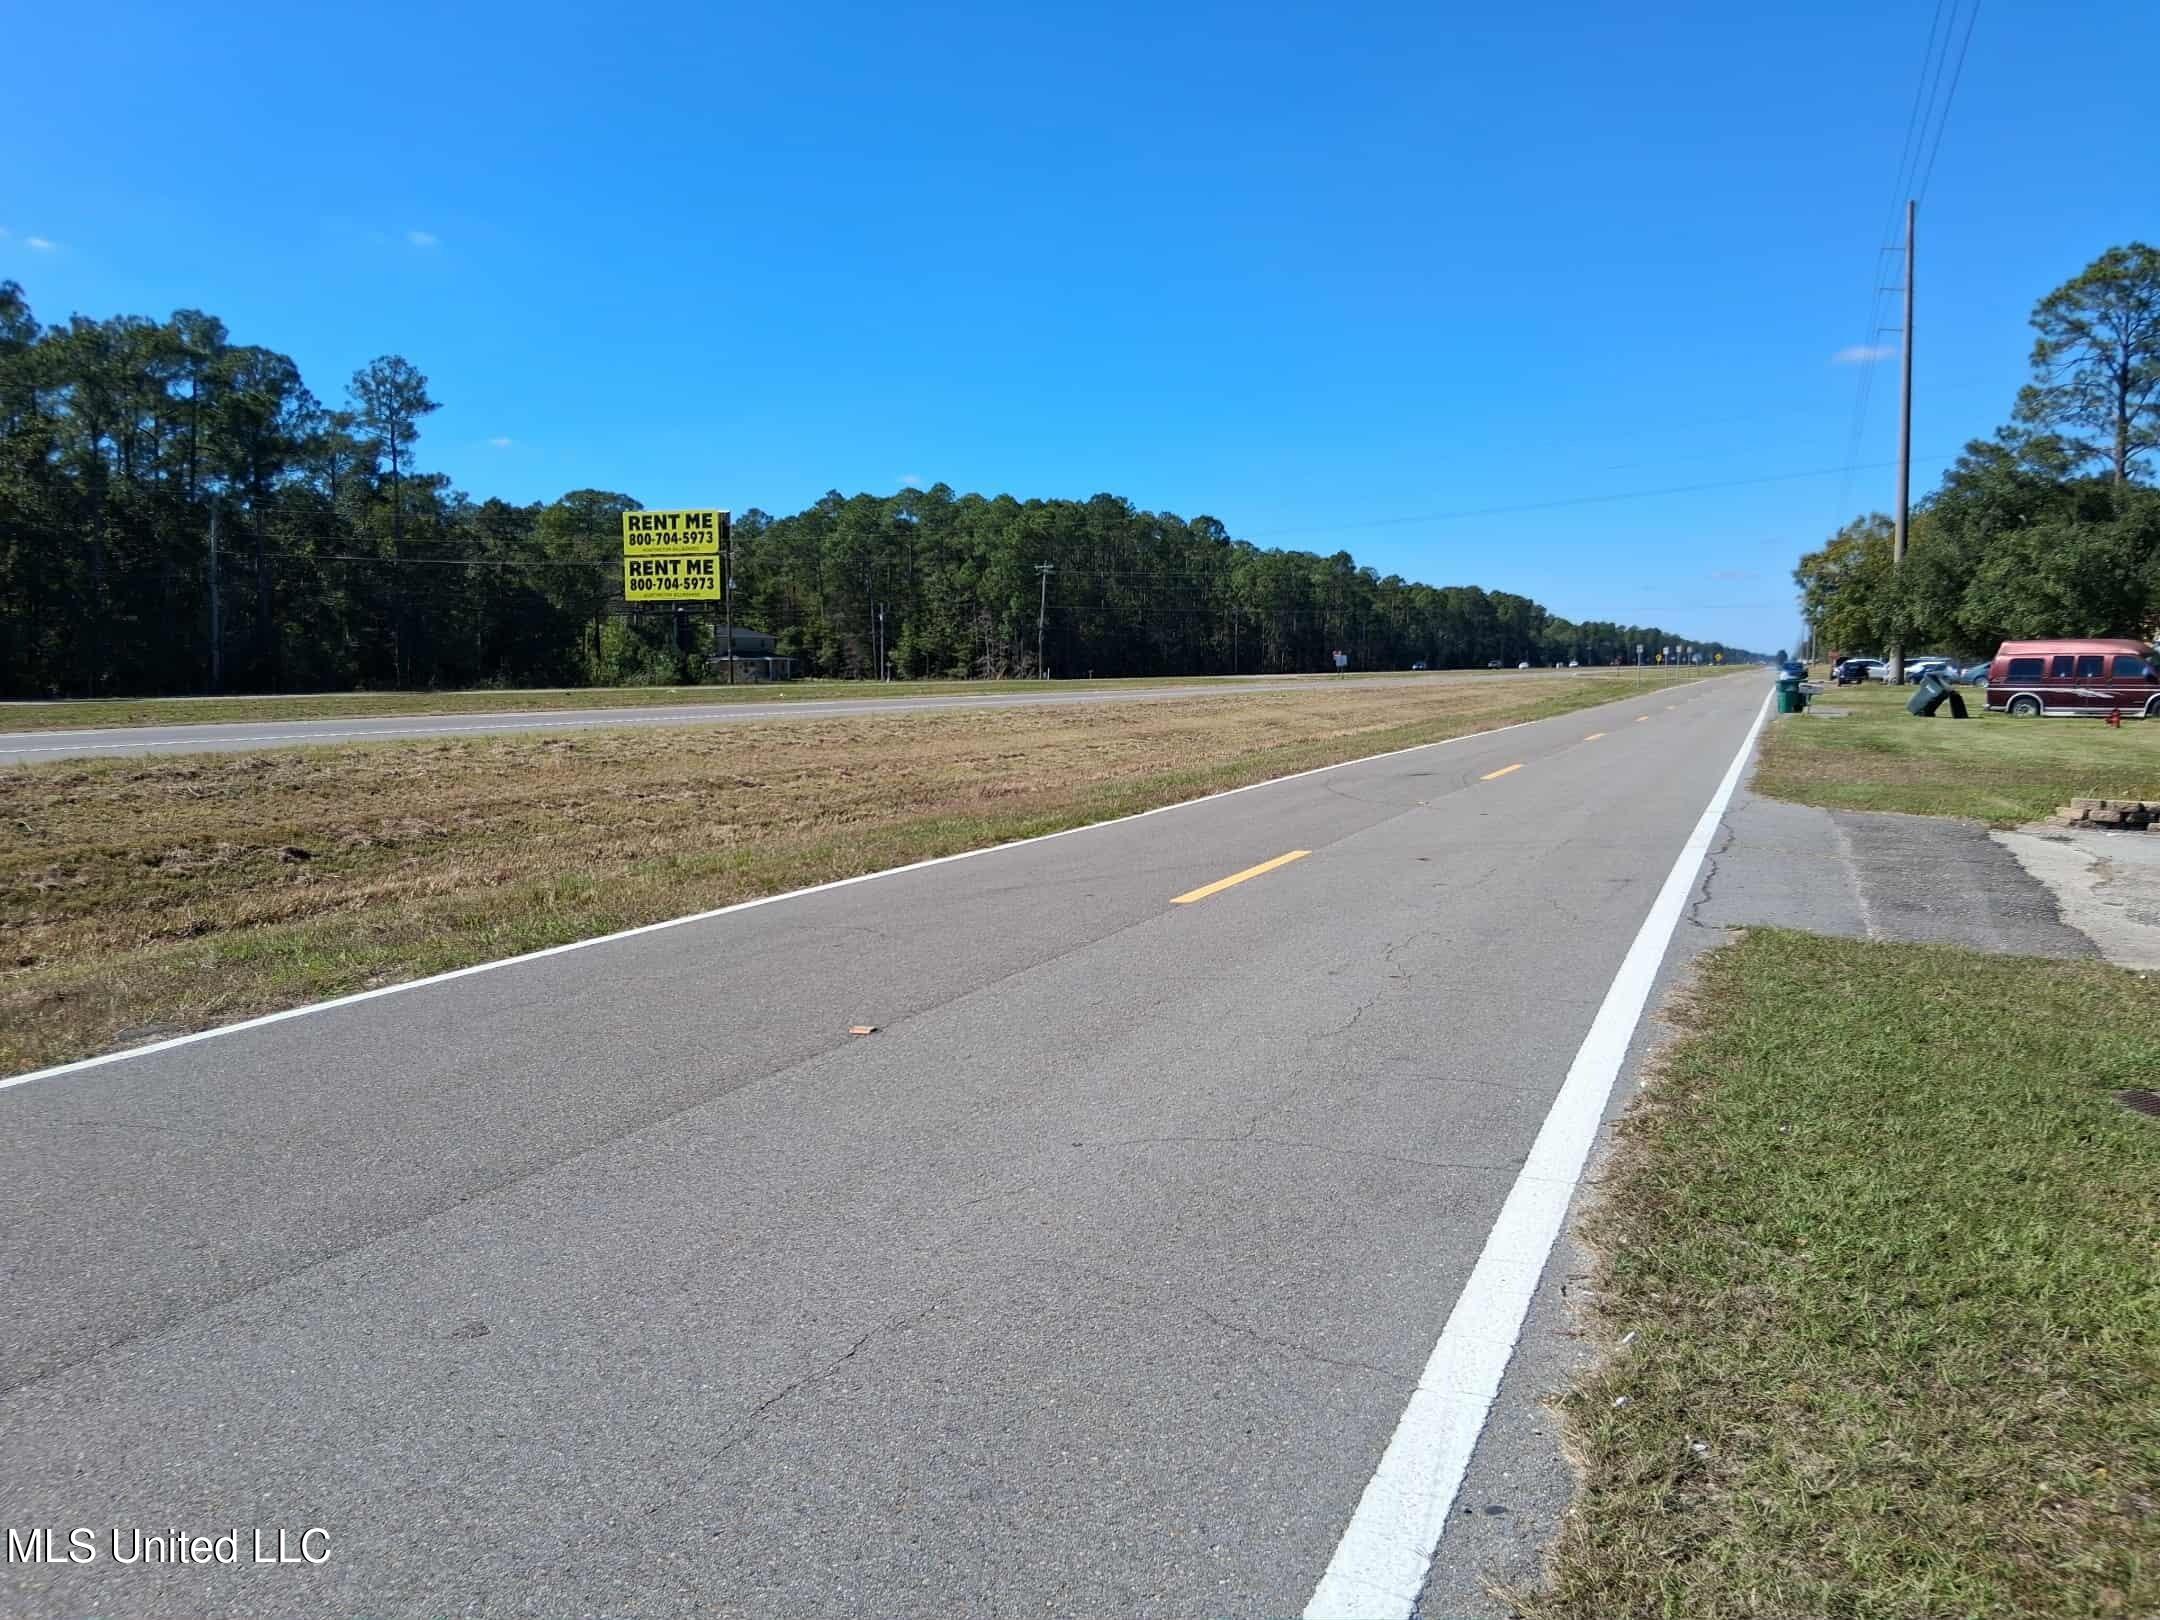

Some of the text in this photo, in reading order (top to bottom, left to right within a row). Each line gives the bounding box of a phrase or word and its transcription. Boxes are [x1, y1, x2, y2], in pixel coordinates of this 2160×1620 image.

[628, 513, 713, 531] RENT ME
[630, 559, 714, 576] RENT ME
